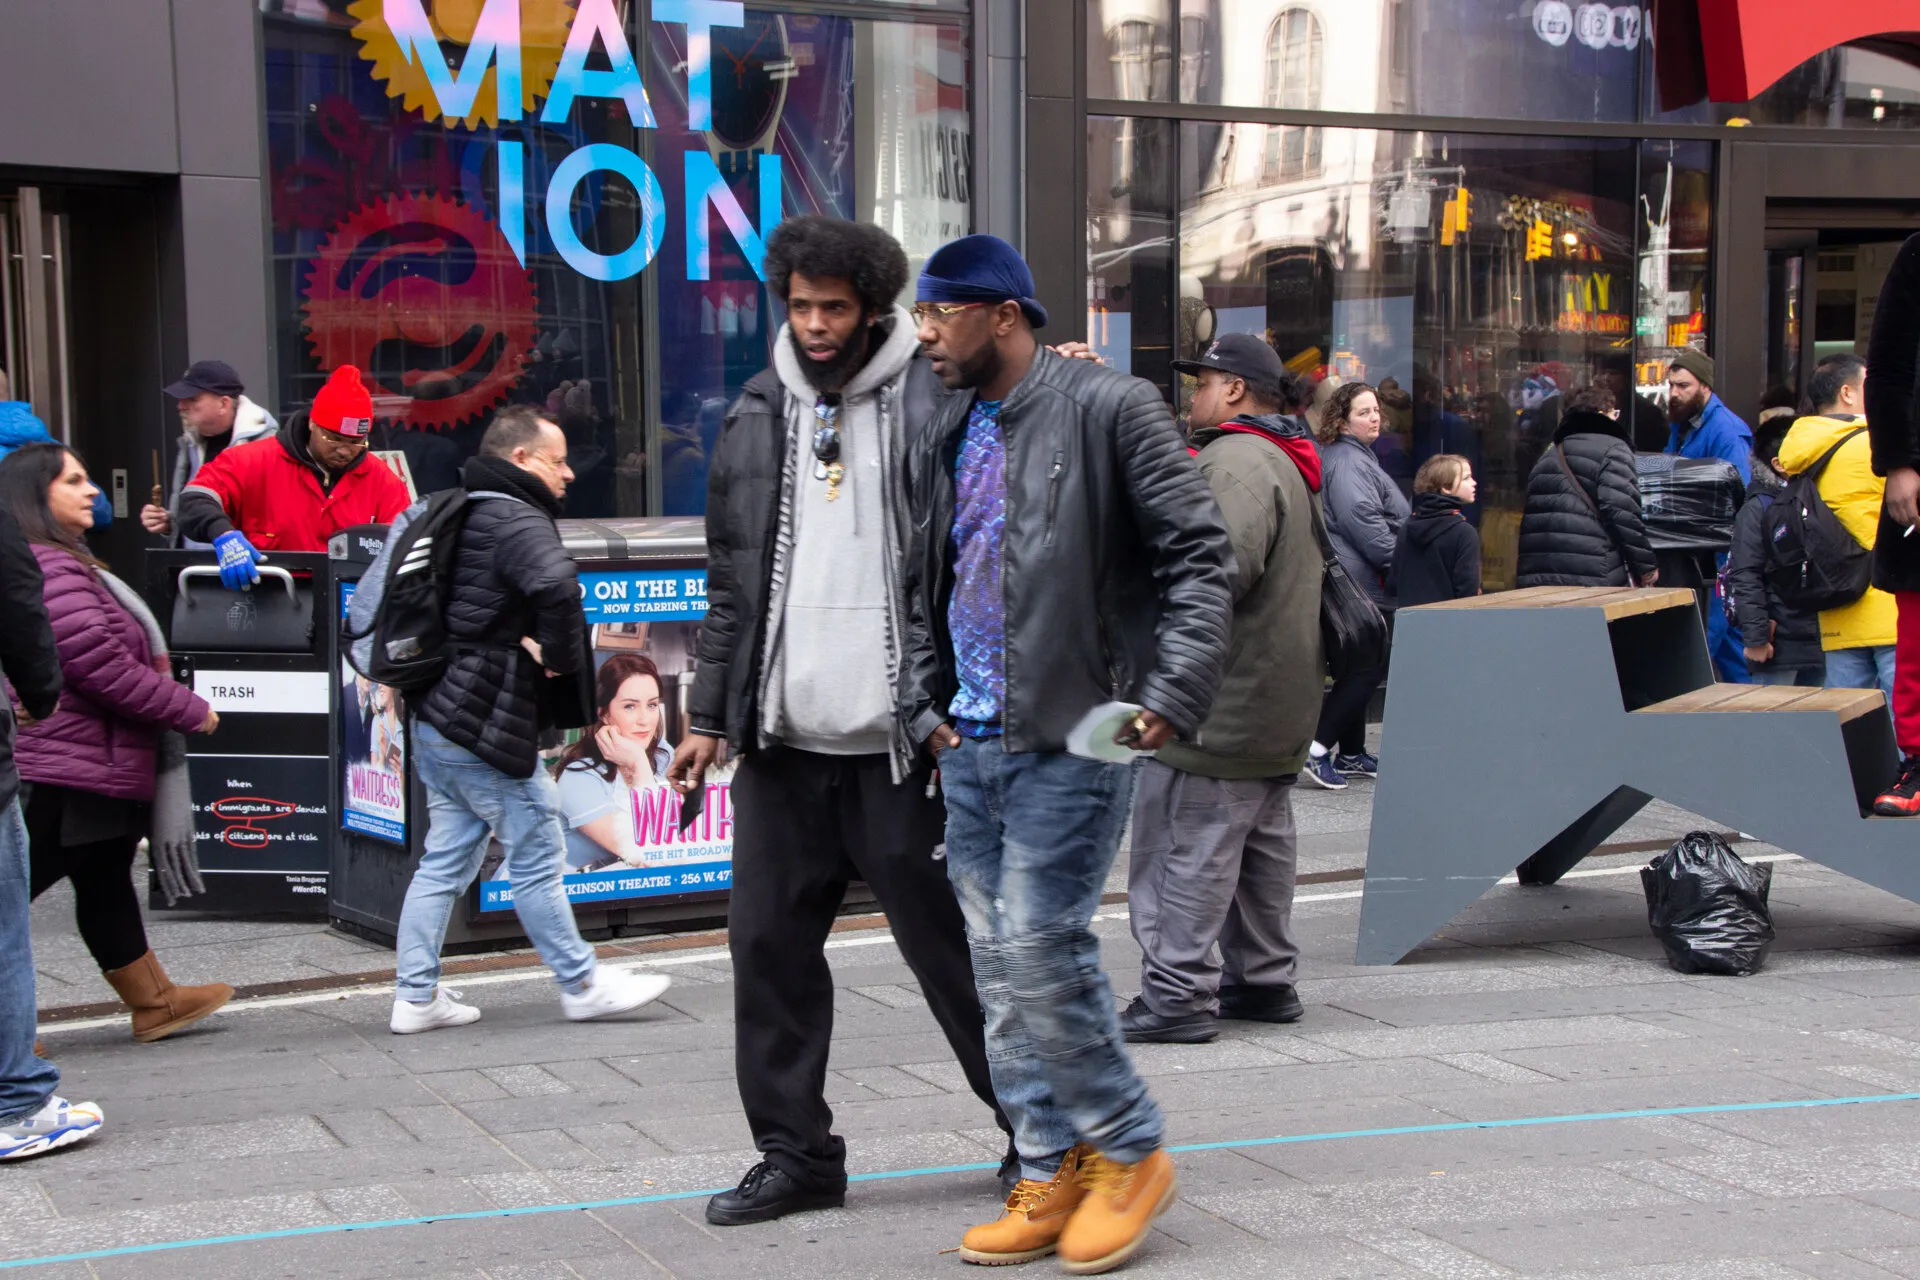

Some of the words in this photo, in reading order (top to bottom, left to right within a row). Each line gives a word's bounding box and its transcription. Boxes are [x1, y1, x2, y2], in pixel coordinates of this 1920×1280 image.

[383, 0, 745, 131] MAT
[498, 140, 782, 282] ION
[359, 536, 383, 550] BigBelly
[594, 581, 628, 600] ON
[635, 579, 677, 599] THE
[684, 578, 707, 597] BL
[603, 603, 631, 614] NOW
[634, 601, 688, 613] STARRING
[211, 686, 255, 698] TRASH
[226, 779, 253, 788] When
[351, 767, 401, 809] WAITRESS
[204, 802, 215, 812] of
[218, 803, 271, 814] immigrants
[275, 805, 291, 813] are
[294, 804, 327, 814] denied
[214, 831, 226, 843] of
[228, 832, 266, 841] citizens
[267, 833, 282, 841] are
[285, 832, 296, 841] at
[298, 832, 318, 841] risk
[644, 851, 664, 861] THE
[667, 849, 684, 859] HIT
[618, 876, 671, 891] THEATRE
[681, 873, 701, 885] 256
